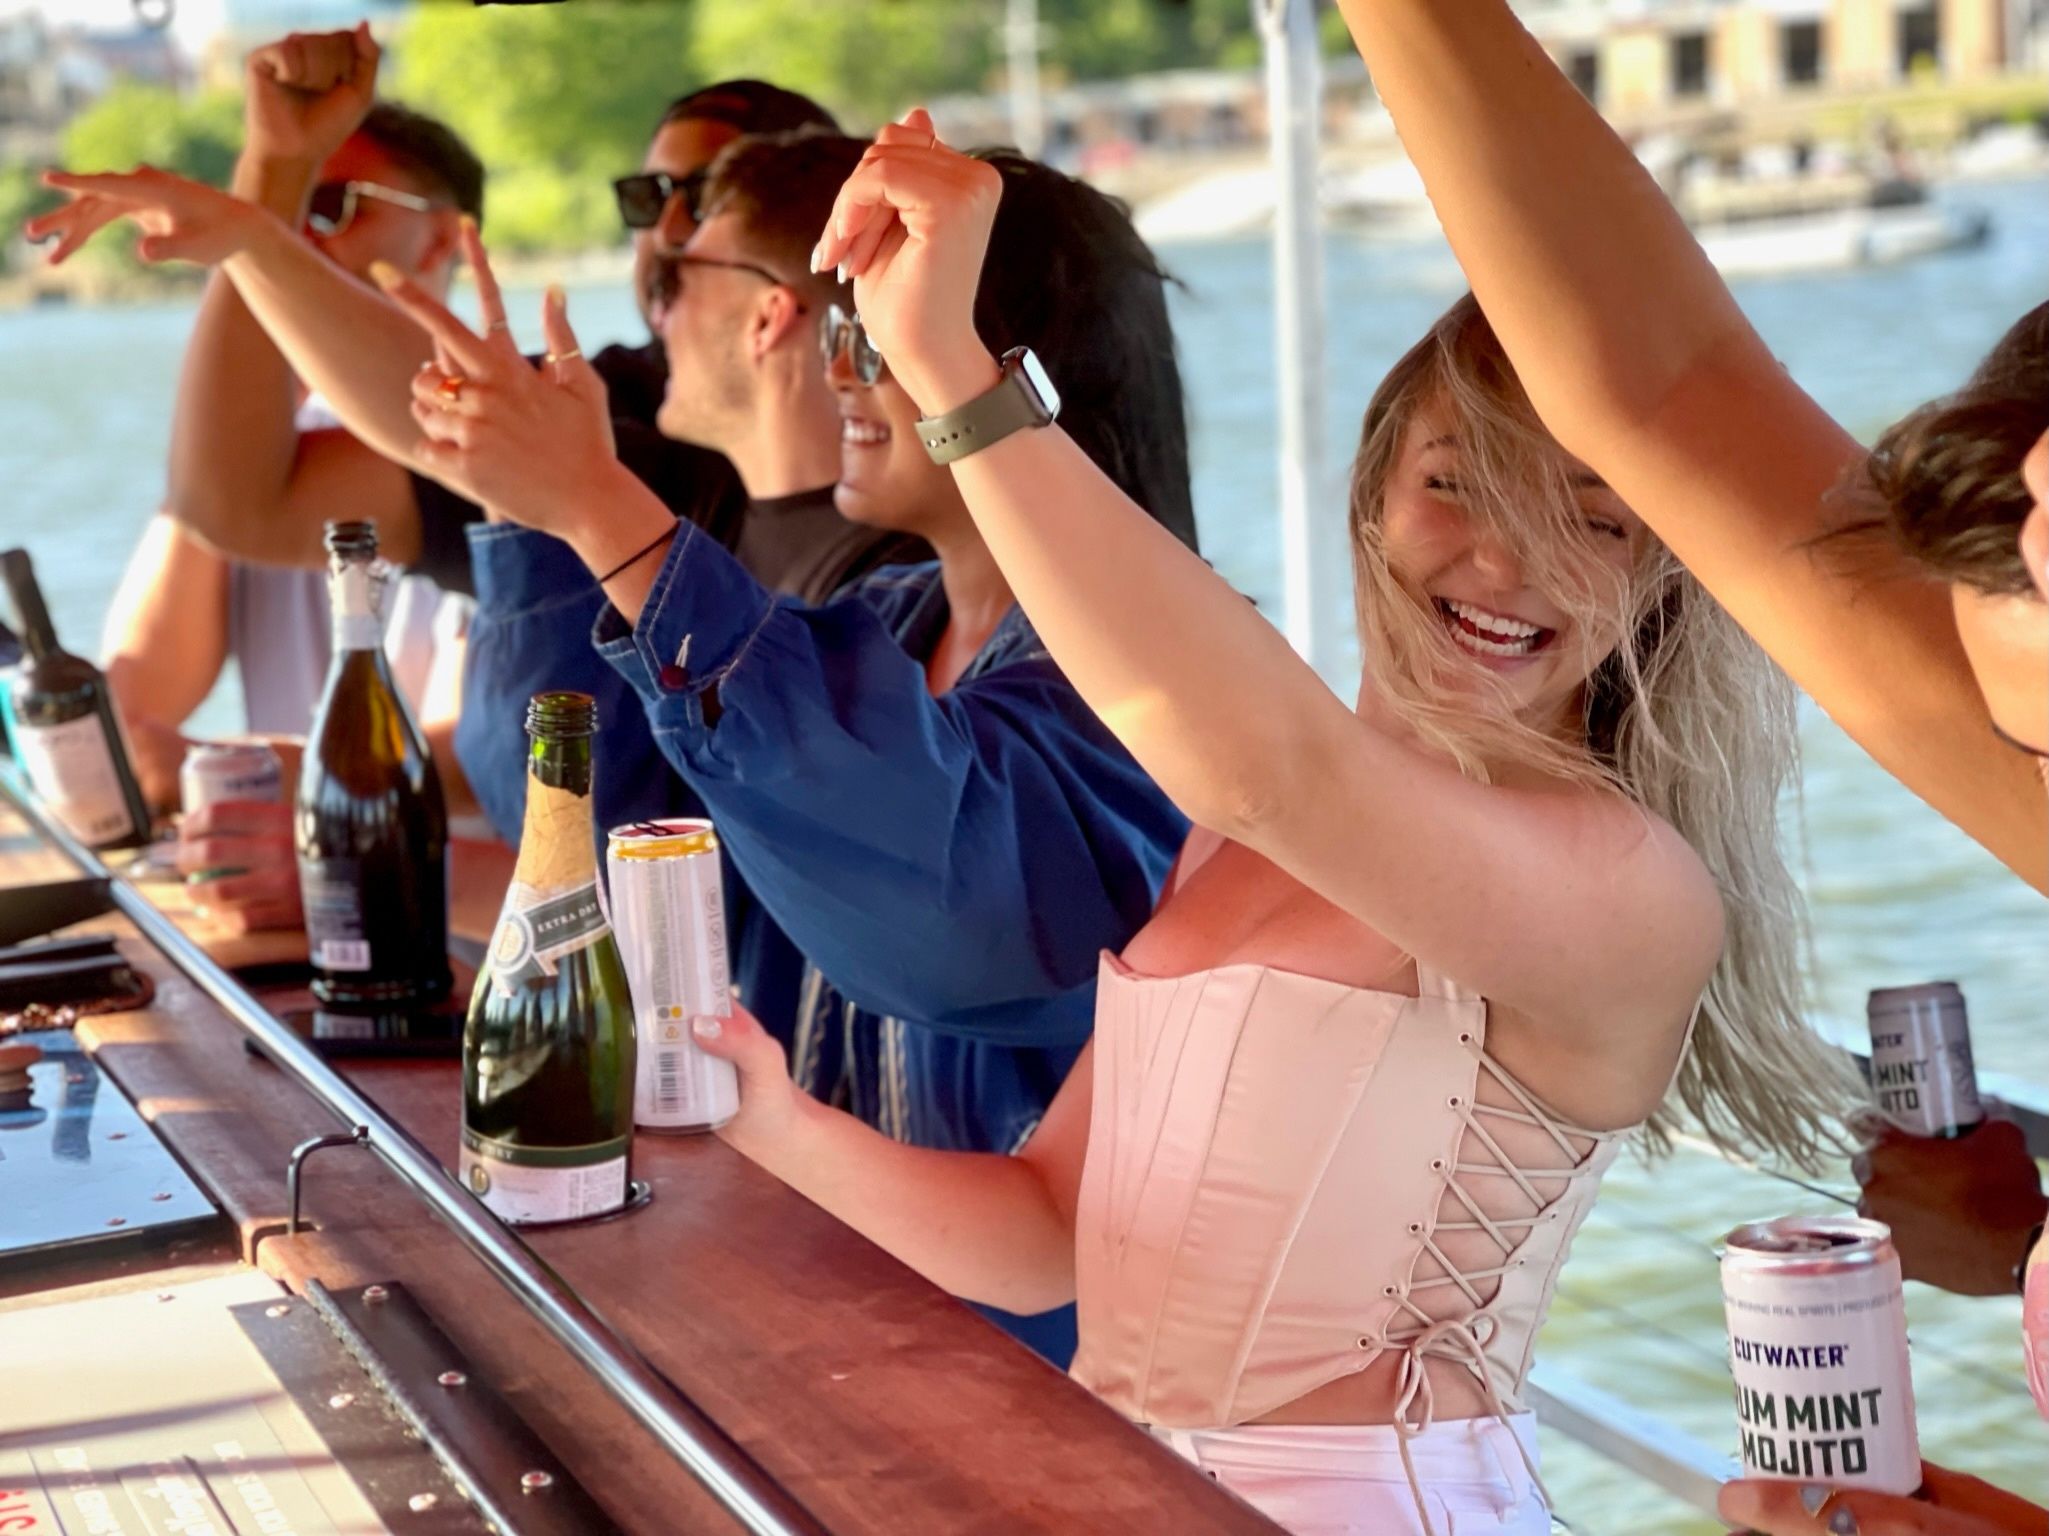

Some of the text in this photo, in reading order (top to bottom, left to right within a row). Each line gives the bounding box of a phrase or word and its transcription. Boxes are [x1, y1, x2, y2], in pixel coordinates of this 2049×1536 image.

[538, 912, 577, 933] EXTRA
[578, 902, 597, 917] DRY
[1879, 1060, 1929, 1085] MINT
[1733, 1336, 1845, 1368] CUTWATER
[1737, 1384, 1882, 1432] UM MINT
[1741, 1427, 1867, 1476] MOJITO
